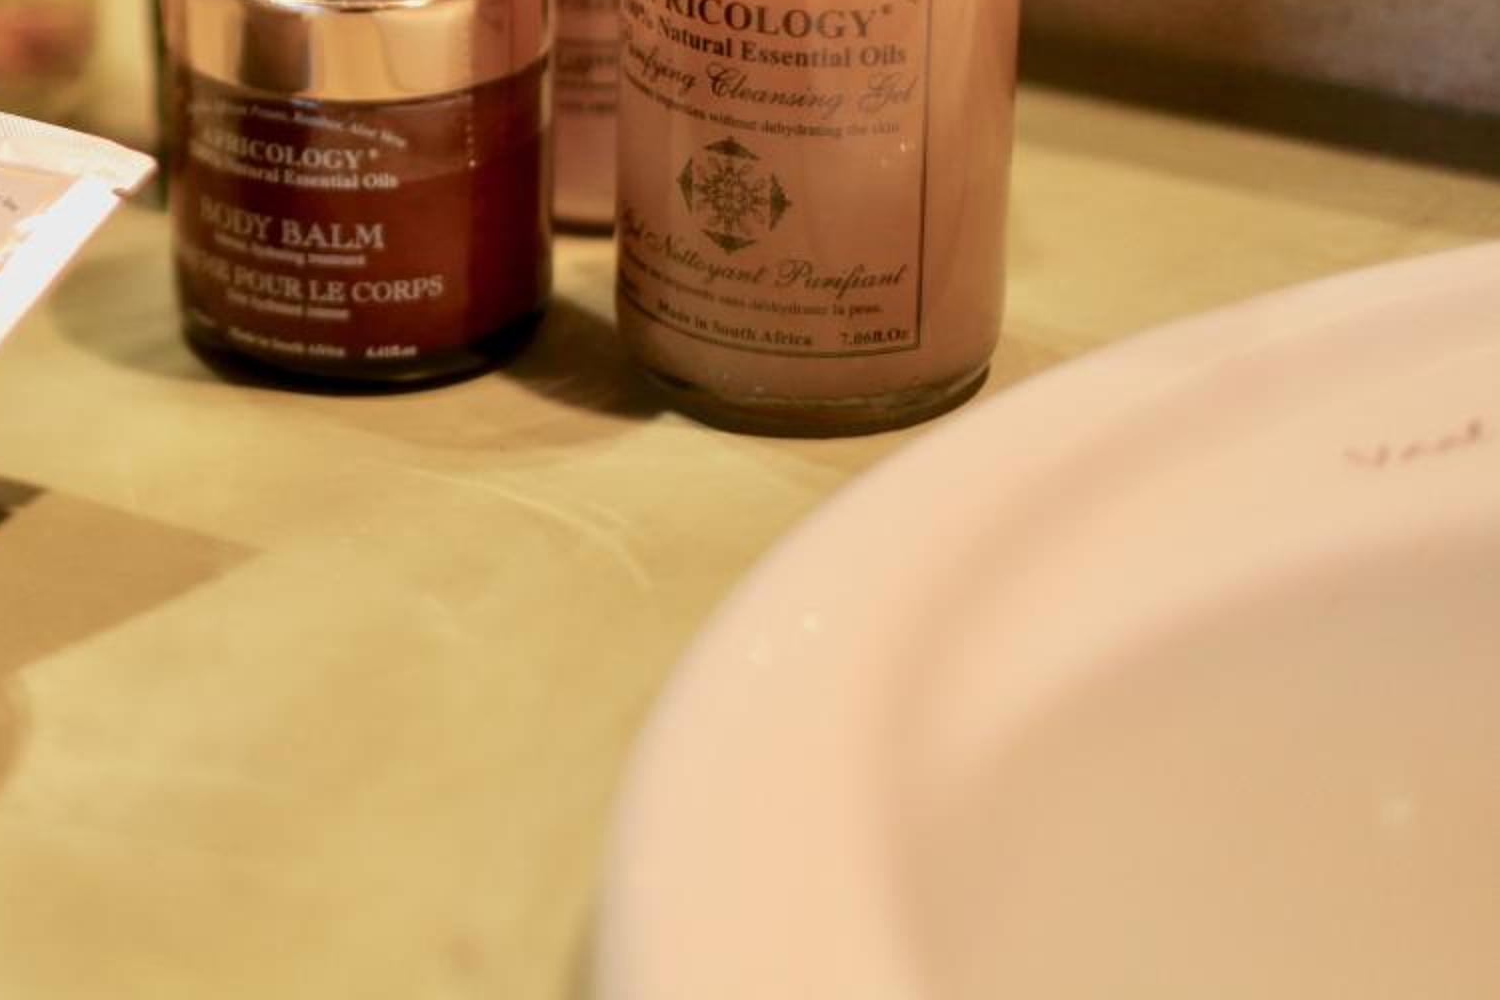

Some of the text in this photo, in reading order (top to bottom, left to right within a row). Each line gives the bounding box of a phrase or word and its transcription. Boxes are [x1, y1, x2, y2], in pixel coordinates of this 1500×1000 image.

[659, 14, 732, 58] Natural
[740, 38, 850, 69] Essential
[860, 44, 906, 68] Oils
[706, 62, 845, 120] Cleansing
[280, 219, 385, 250] BALM
[308, 279, 345, 302] LE
[351, 273, 445, 304] CORPS
